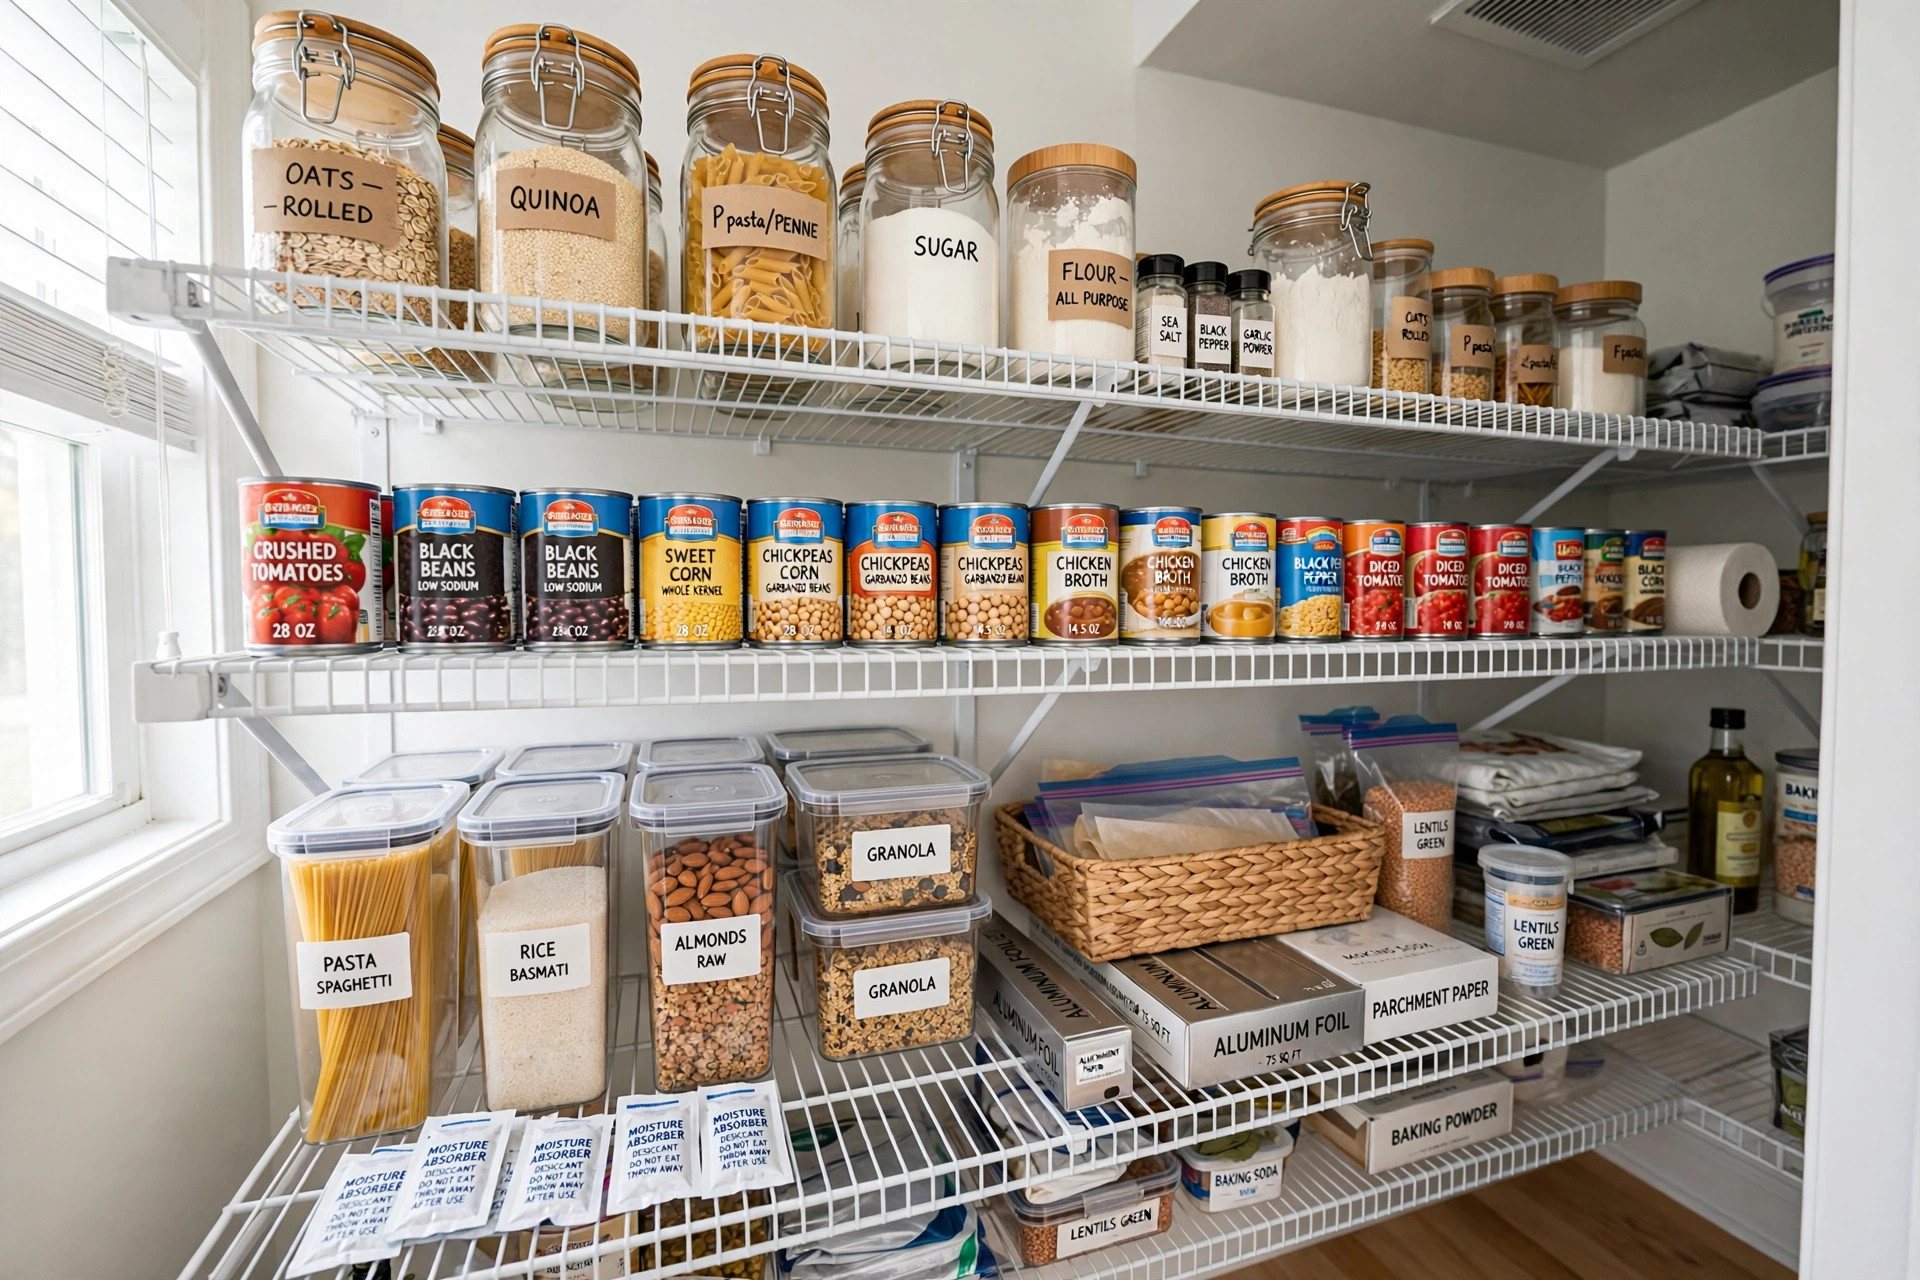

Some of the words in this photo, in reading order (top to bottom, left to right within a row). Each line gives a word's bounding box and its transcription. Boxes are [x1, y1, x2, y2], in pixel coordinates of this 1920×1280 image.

[510, 186, 600, 219] QUINOA
[712, 204, 725, 229] P
[914, 236, 979, 262] SUGAR
[1062, 261, 1117, 285] FLOUR
[1055, 290, 1078, 306] ALL
[1083, 291, 1129, 312] PURPOSE
[1161, 315, 1178, 328] SEA
[1159, 330, 1182, 343] SALT
[1200, 324, 1227, 337] BLACK
[1199, 338, 1229, 351] PEPPER
[253, 541, 336, 560] CRUSHED
[419, 543, 474, 560] BLACK
[545, 545, 597, 561] BLACK
[665, 548, 716, 563] SWEET
[762, 549, 833, 563] CHICKPEAS
[861, 556, 930, 571] CHICKPEAS
[958, 557, 1023, 571] CHICKPEAS
[1057, 556, 1111, 570] CHICKEN
[1147, 555, 1194, 568] CHICKEN
[1222, 557, 1271, 570] CHICKEN
[1294, 557, 1328, 570] BLACK
[1370, 560, 1399, 573] DICED
[1436, 561, 1464, 573] DICED
[1498, 563, 1527, 575] DICED
[251, 563, 343, 582] TOMATOES
[420, 562, 476, 578] BEANS
[547, 563, 599, 579] BEANS
[670, 567, 712, 582] CORN
[780, 565, 819, 580] CORN
[1155, 570, 1190, 584] BROTH
[418, 580, 438, 591] LOW
[440, 580, 479, 591] SODIUM
[865, 574, 907, 584] GARBANZO
[964, 574, 1005, 584] GARBANZO
[1065, 573, 1108, 587] BROTH
[1230, 573, 1268, 586] BROTH
[544, 582, 564, 592] LOW
[566, 582, 602, 592] SODIUM
[662, 585, 690, 596] WHOLE
[693, 585, 723, 596] KERNEL
[273, 623, 290, 638] 28
[295, 623, 316, 638] OZ
[675, 624, 689, 636] 28
[693, 624, 709, 636] OZ
[784, 625, 796, 636] 28
[1068, 624, 1087, 635] 14.5
[1088, 623, 1100, 634] OZ
[1414, 820, 1449, 834] LENTILS
[1417, 837, 1445, 850] GREEN
[867, 842, 936, 862] GRANOLA
[1513, 919, 1560, 935] LENTILS
[675, 929, 747, 951] ALMONDS
[1518, 936, 1555, 951] GREEN
[520, 941, 556, 959] RICE
[324, 953, 377, 972] PASTA
[697, 953, 726, 968] RAW
[510, 963, 569, 982] BASMATI
[317, 974, 392, 995] SPAGHETTI
[868, 976, 936, 999] GRANOLA
[1373, 988, 1449, 1019] PARCHMENT
[1453, 980, 1489, 1003] PAPER
[1160, 1027, 1171, 1044] FT
[1213, 1019, 1309, 1057] ALUMINUM
[1315, 1012, 1350, 1036] FOIL
[1037, 1035, 1059, 1077] FOIL
[1266, 1055, 1276, 1066] 75
[1291, 1049, 1301, 1060] FT
[713, 1108, 766, 1125] MOISTURE
[1392, 1118, 1441, 1146] BAKING
[1445, 1102, 1498, 1131] POWDER
[628, 1119, 683, 1138] MOISTURE
[713, 1118, 768, 1136] ABSORBER
[534, 1138, 592, 1154] MOISTURE
[627, 1130, 685, 1149] ABSORBER
[427, 1140, 489, 1157] MOISTURE
[421, 1151, 487, 1169] ABSORBER
[530, 1149, 591, 1165] ABSORBER
[751, 1156, 767, 1165] USE
[344, 1170, 407, 1189] MOISTURE
[1215, 1171, 1252, 1187] BAKING
[1254, 1164, 1279, 1181] SODA
[446, 1195, 465, 1205] USE
[558, 1190, 576, 1200] USE
[359, 1226, 378, 1236] USE
[1070, 1217, 1117, 1241] LENTILS
